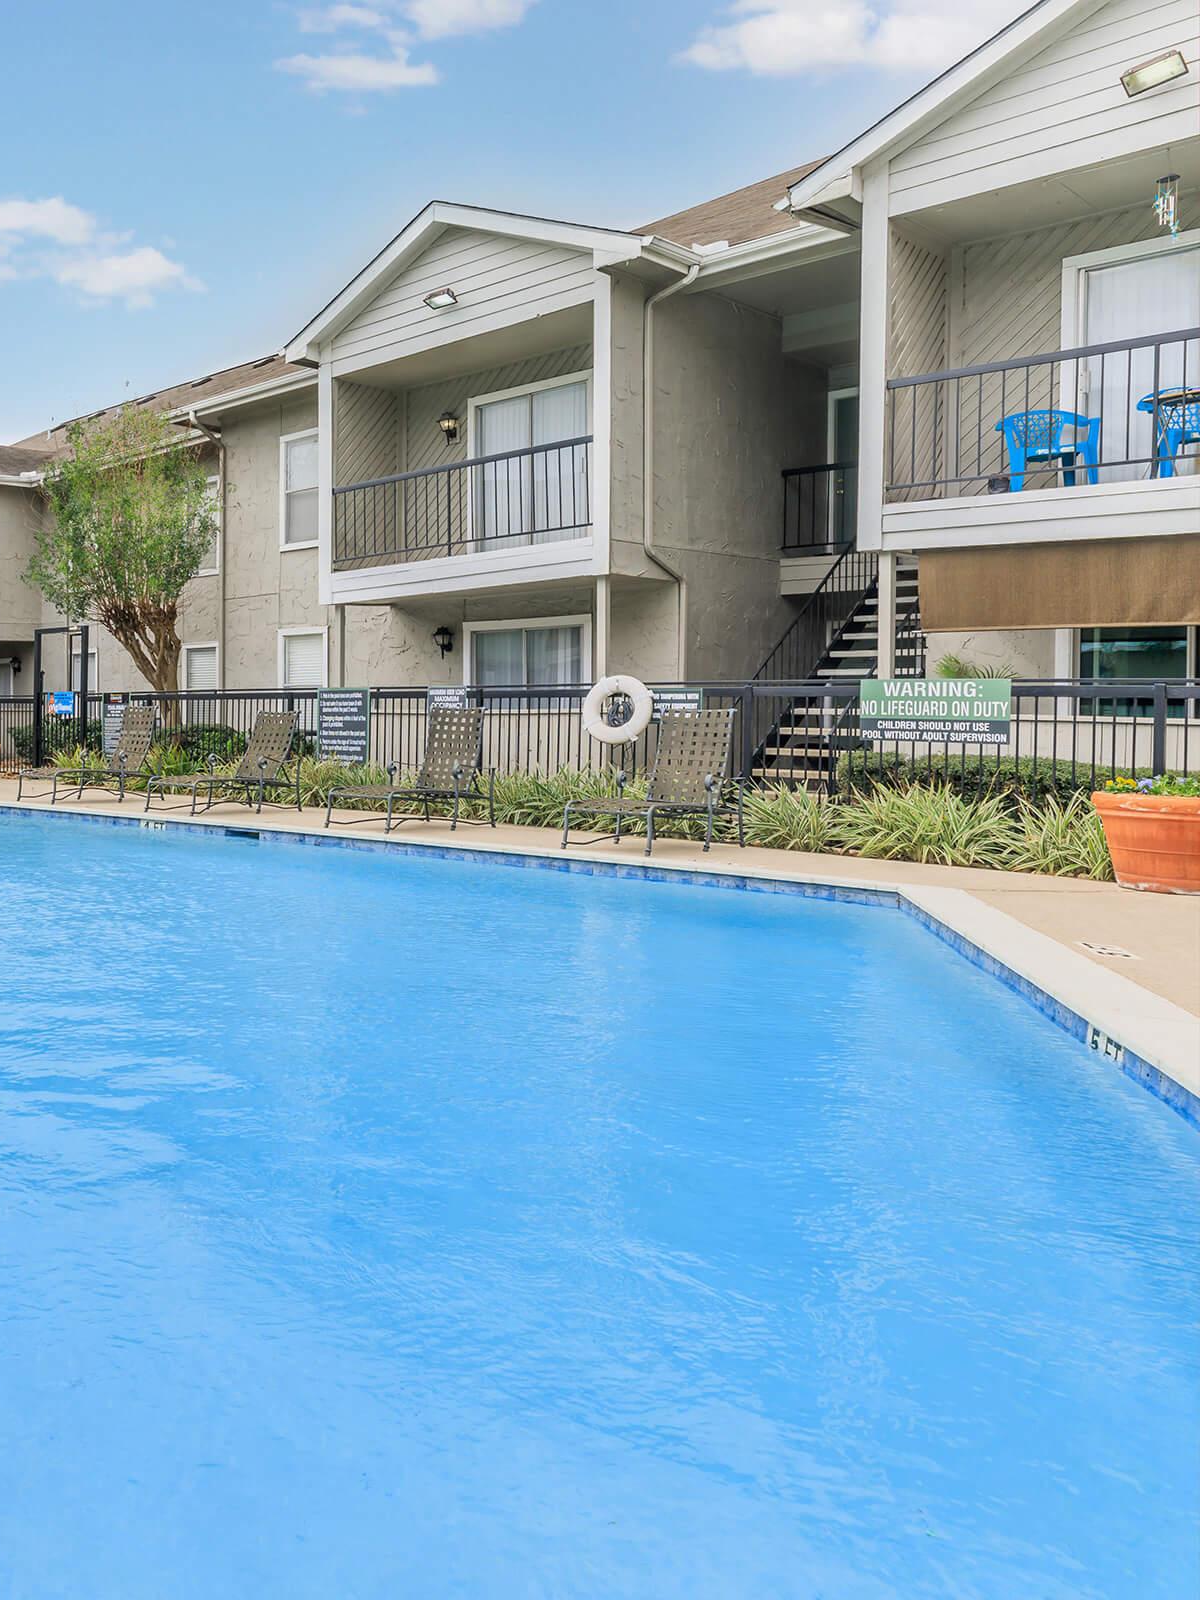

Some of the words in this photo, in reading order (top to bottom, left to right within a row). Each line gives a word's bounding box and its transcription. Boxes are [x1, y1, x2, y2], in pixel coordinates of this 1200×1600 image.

[883, 681, 983, 697] WARNING:
[861, 700, 877, 715] NO
[881, 700, 947, 716] LIFEGUARD
[951, 701, 969, 717] ON
[974, 702, 1008, 718] DUTY
[877, 721, 916, 730] CHILDREN
[918, 721, 951, 731] SHOULD
[954, 722, 971, 731] NOT
[972, 722, 990, 732] USE
[862, 730, 883, 739] POOL
[884, 730, 921, 740] WITHOUT
[923, 731, 949, 741] ADULT
[950, 732, 1007, 743] SUPERVISION
[1090, 1027, 1102, 1050] 5
